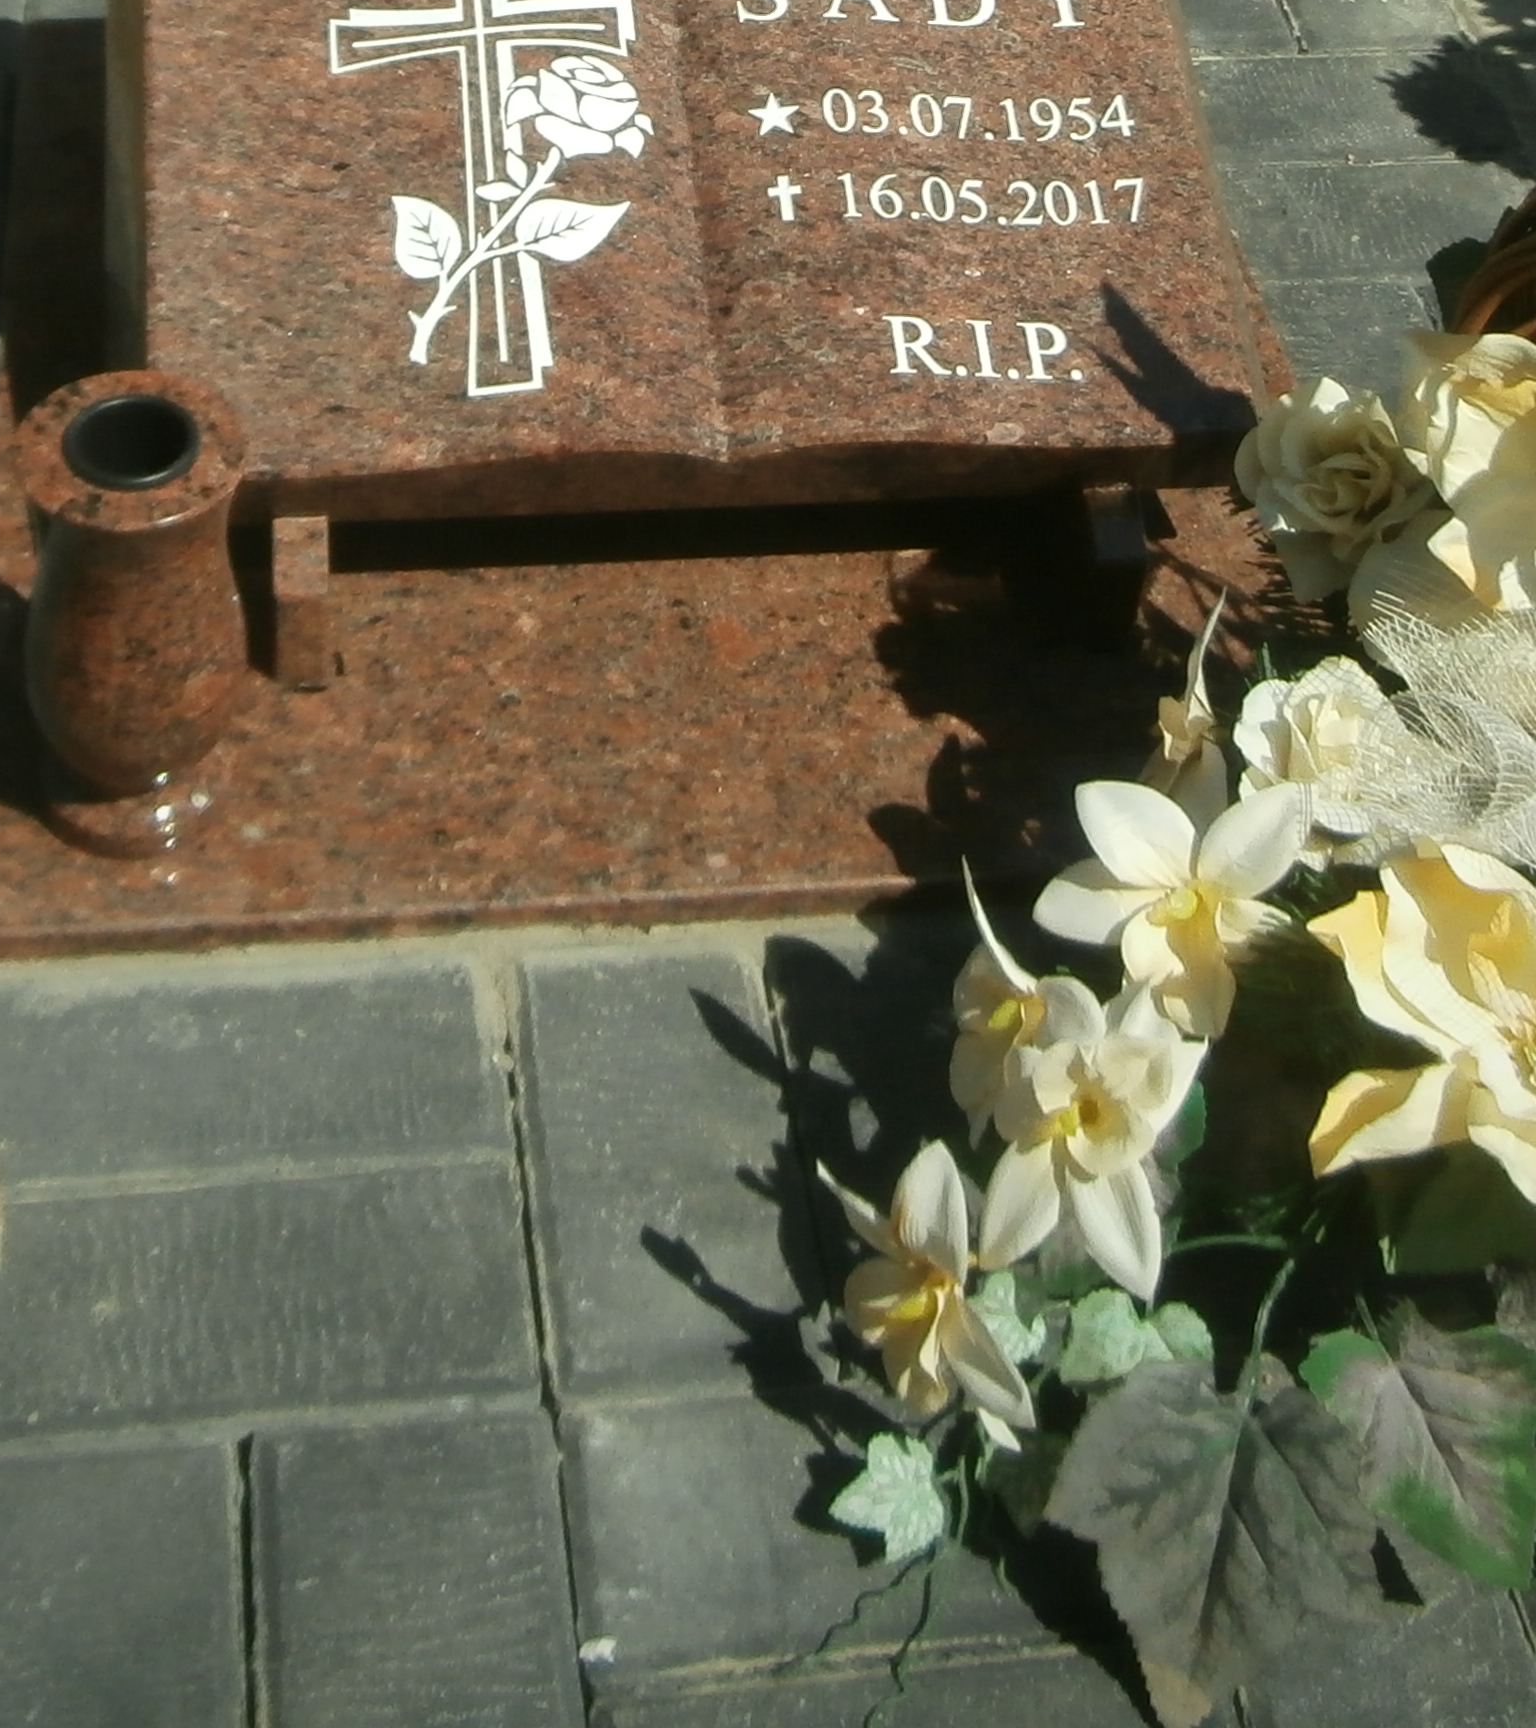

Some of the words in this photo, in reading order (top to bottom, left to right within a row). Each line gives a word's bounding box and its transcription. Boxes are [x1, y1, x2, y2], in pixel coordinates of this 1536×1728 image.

[821, 88, 1136, 142] 03.07.1954
[837, 173, 1147, 226] 16.05.2017
[882, 315, 1086, 382] R.I.P.
